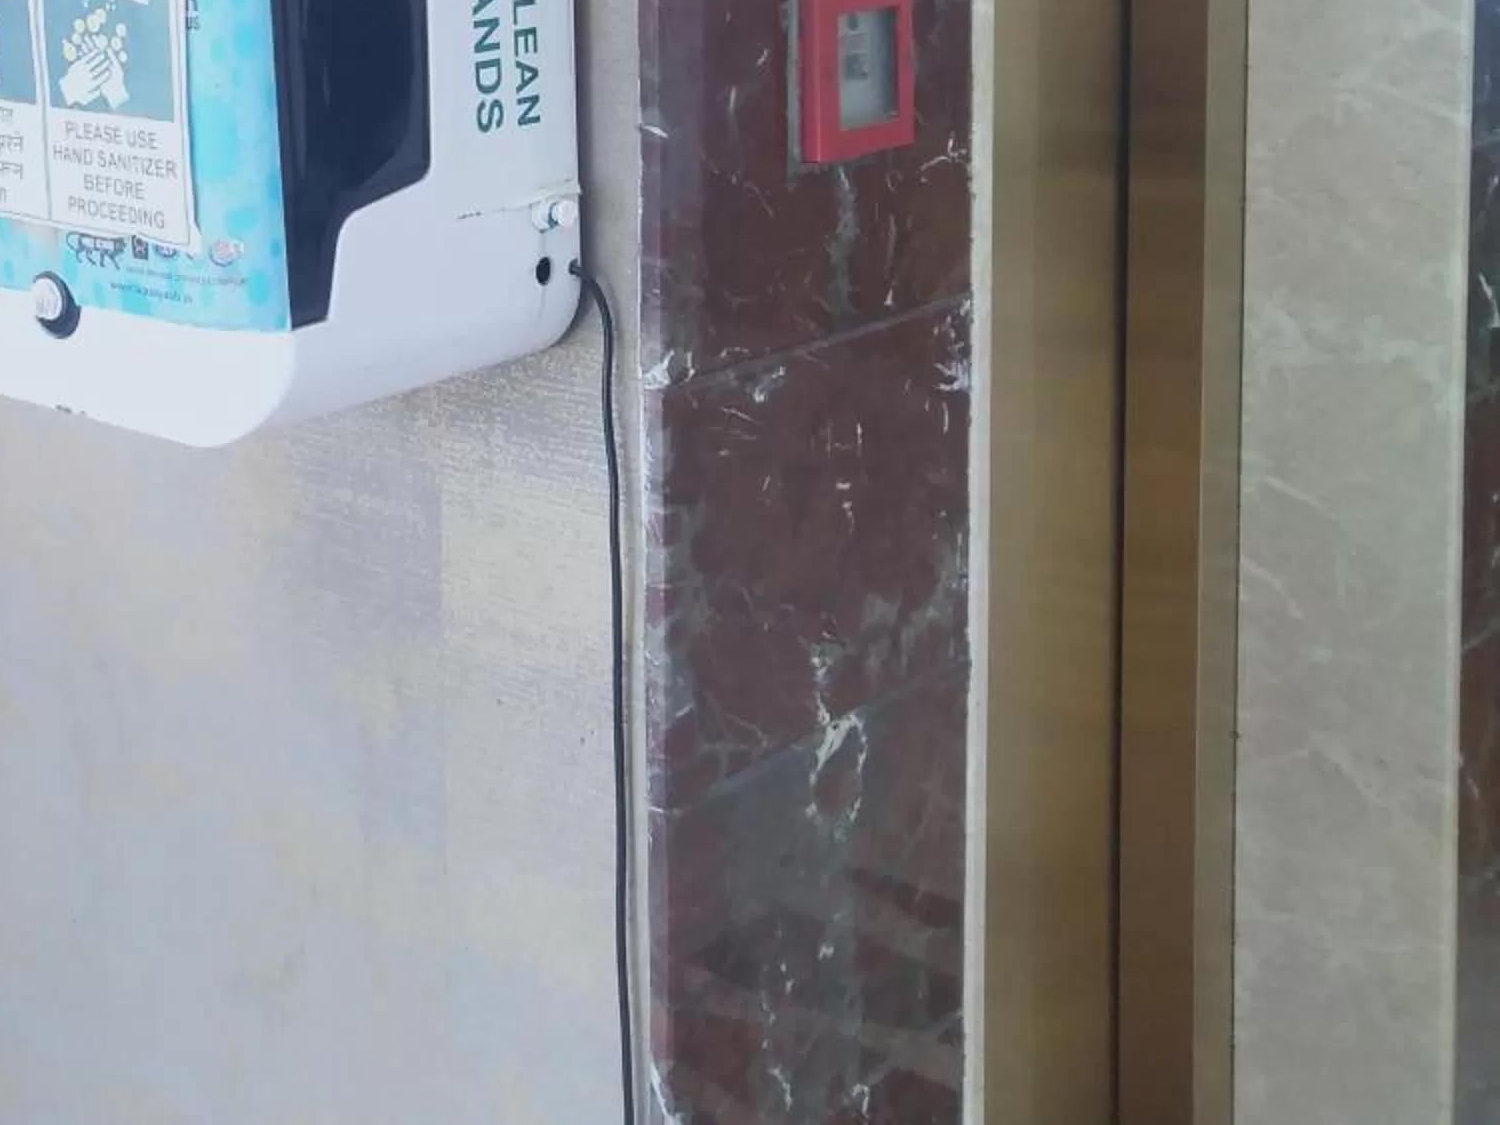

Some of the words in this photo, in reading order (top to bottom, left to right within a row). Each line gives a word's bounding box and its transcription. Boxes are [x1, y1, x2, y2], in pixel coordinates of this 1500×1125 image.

[64, 120, 123, 145] PLEASE
[126, 130, 159, 150] USE
[52, 144, 93, 166] HAND
[97, 150, 178, 179] SANITIZER
[83, 174, 145, 200] BEFORE
[67, 195, 165, 230] PROCEEDING
